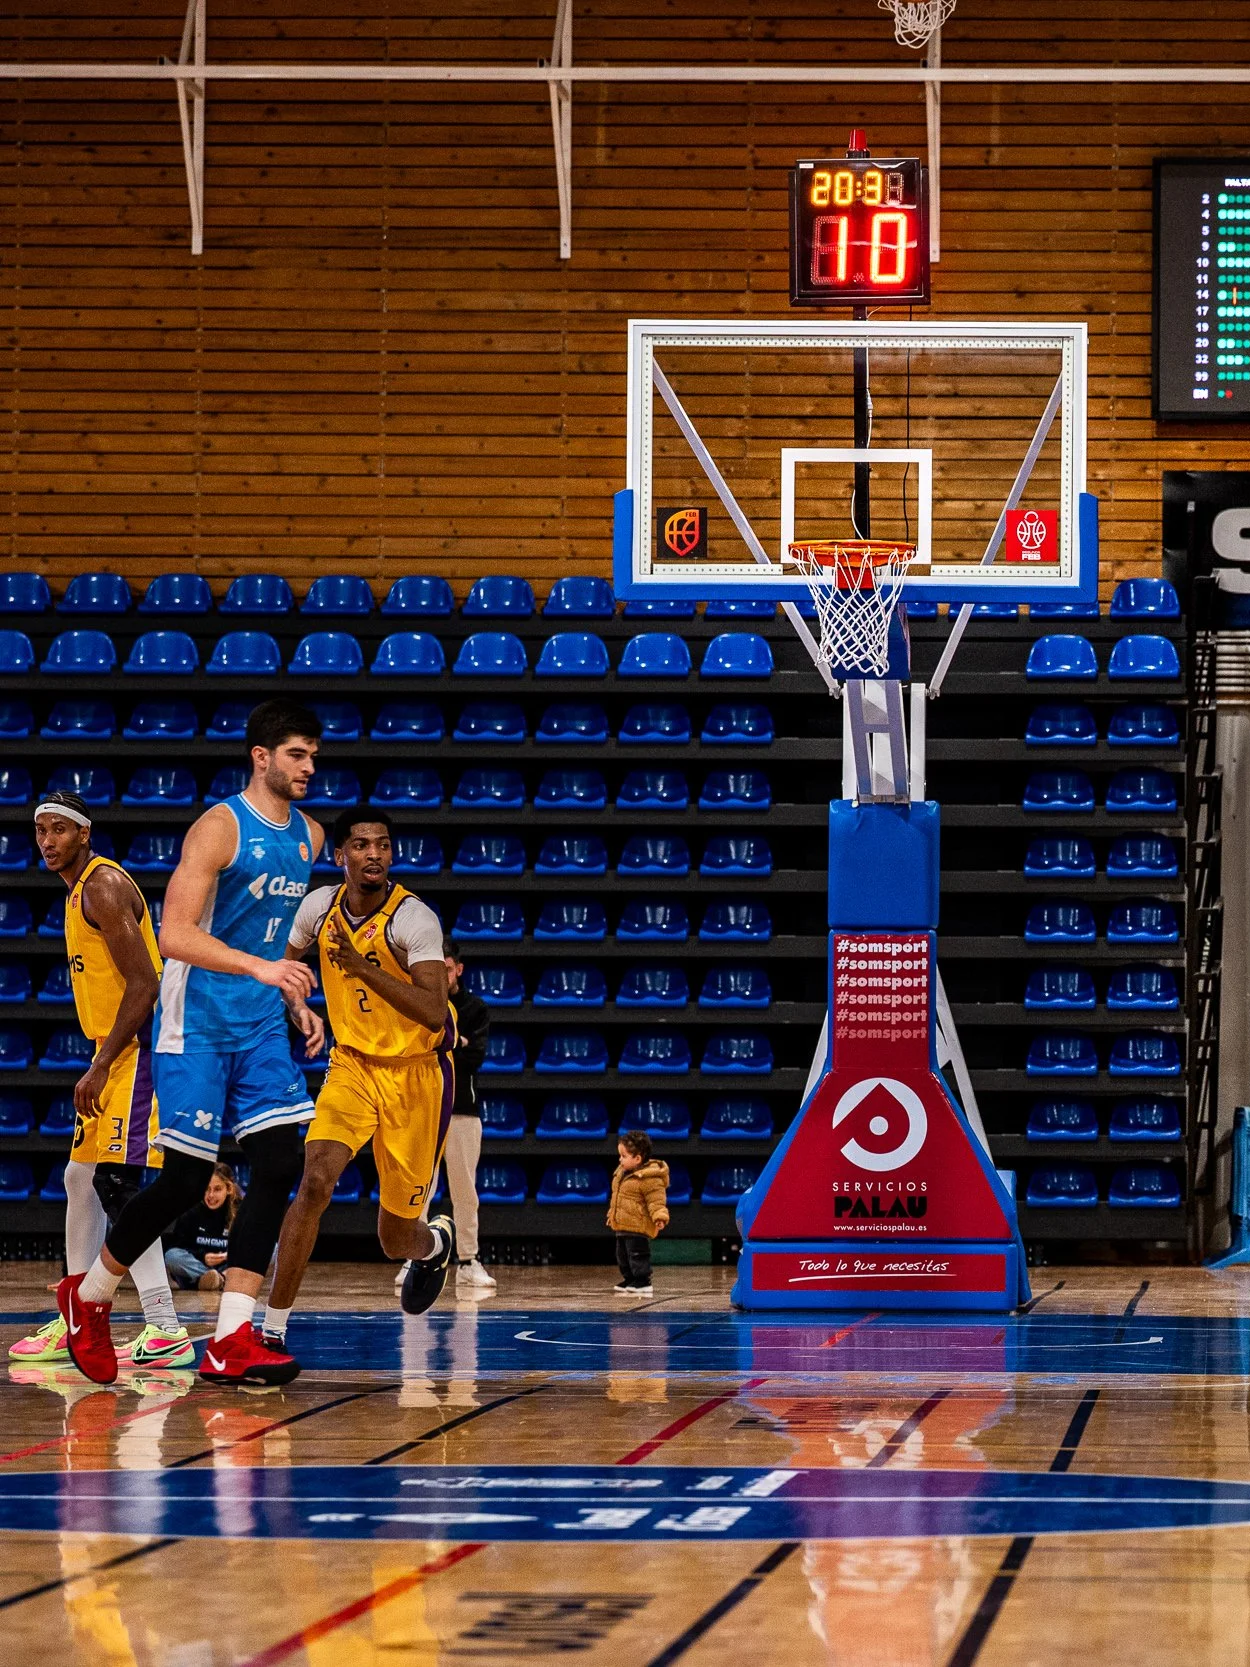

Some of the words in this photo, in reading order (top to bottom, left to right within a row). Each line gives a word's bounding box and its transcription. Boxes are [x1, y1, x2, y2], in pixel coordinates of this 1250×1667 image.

[1202, 193, 1210, 204] 2
[1202, 209, 1210, 220] 4
[1202, 226, 1210, 236] 5
[837, 213, 907, 284] 10
[1196, 257, 1210, 267] 10
[1196, 274, 1209, 284] 11
[1196, 290, 1209, 299] 14
[1196, 306, 1209, 316] 17
[1195, 338, 1209, 348] 20
[1195, 354, 1209, 364] 32
[837, 940, 928, 956] #somsport
[837, 957, 928, 973] #somsport
[837, 974, 928, 990] #somsport
[356, 988, 372, 1012] 2
[837, 992, 928, 1008] #somsport
[837, 1009, 928, 1024] #somsport
[837, 1026, 928, 1042] #somsport
[111, 1117, 124, 1140] 3
[832, 1182, 927, 1192] SERVICIOS
[834, 1196, 927, 1218] PALAU
[833, 1223, 927, 1232] www.serviciospalau.es
[799, 1260, 829, 1271] Todo
[836, 1260, 847, 1272] lo
[854, 1260, 876, 1272] que
[883, 1260, 949, 1272] necesitas
